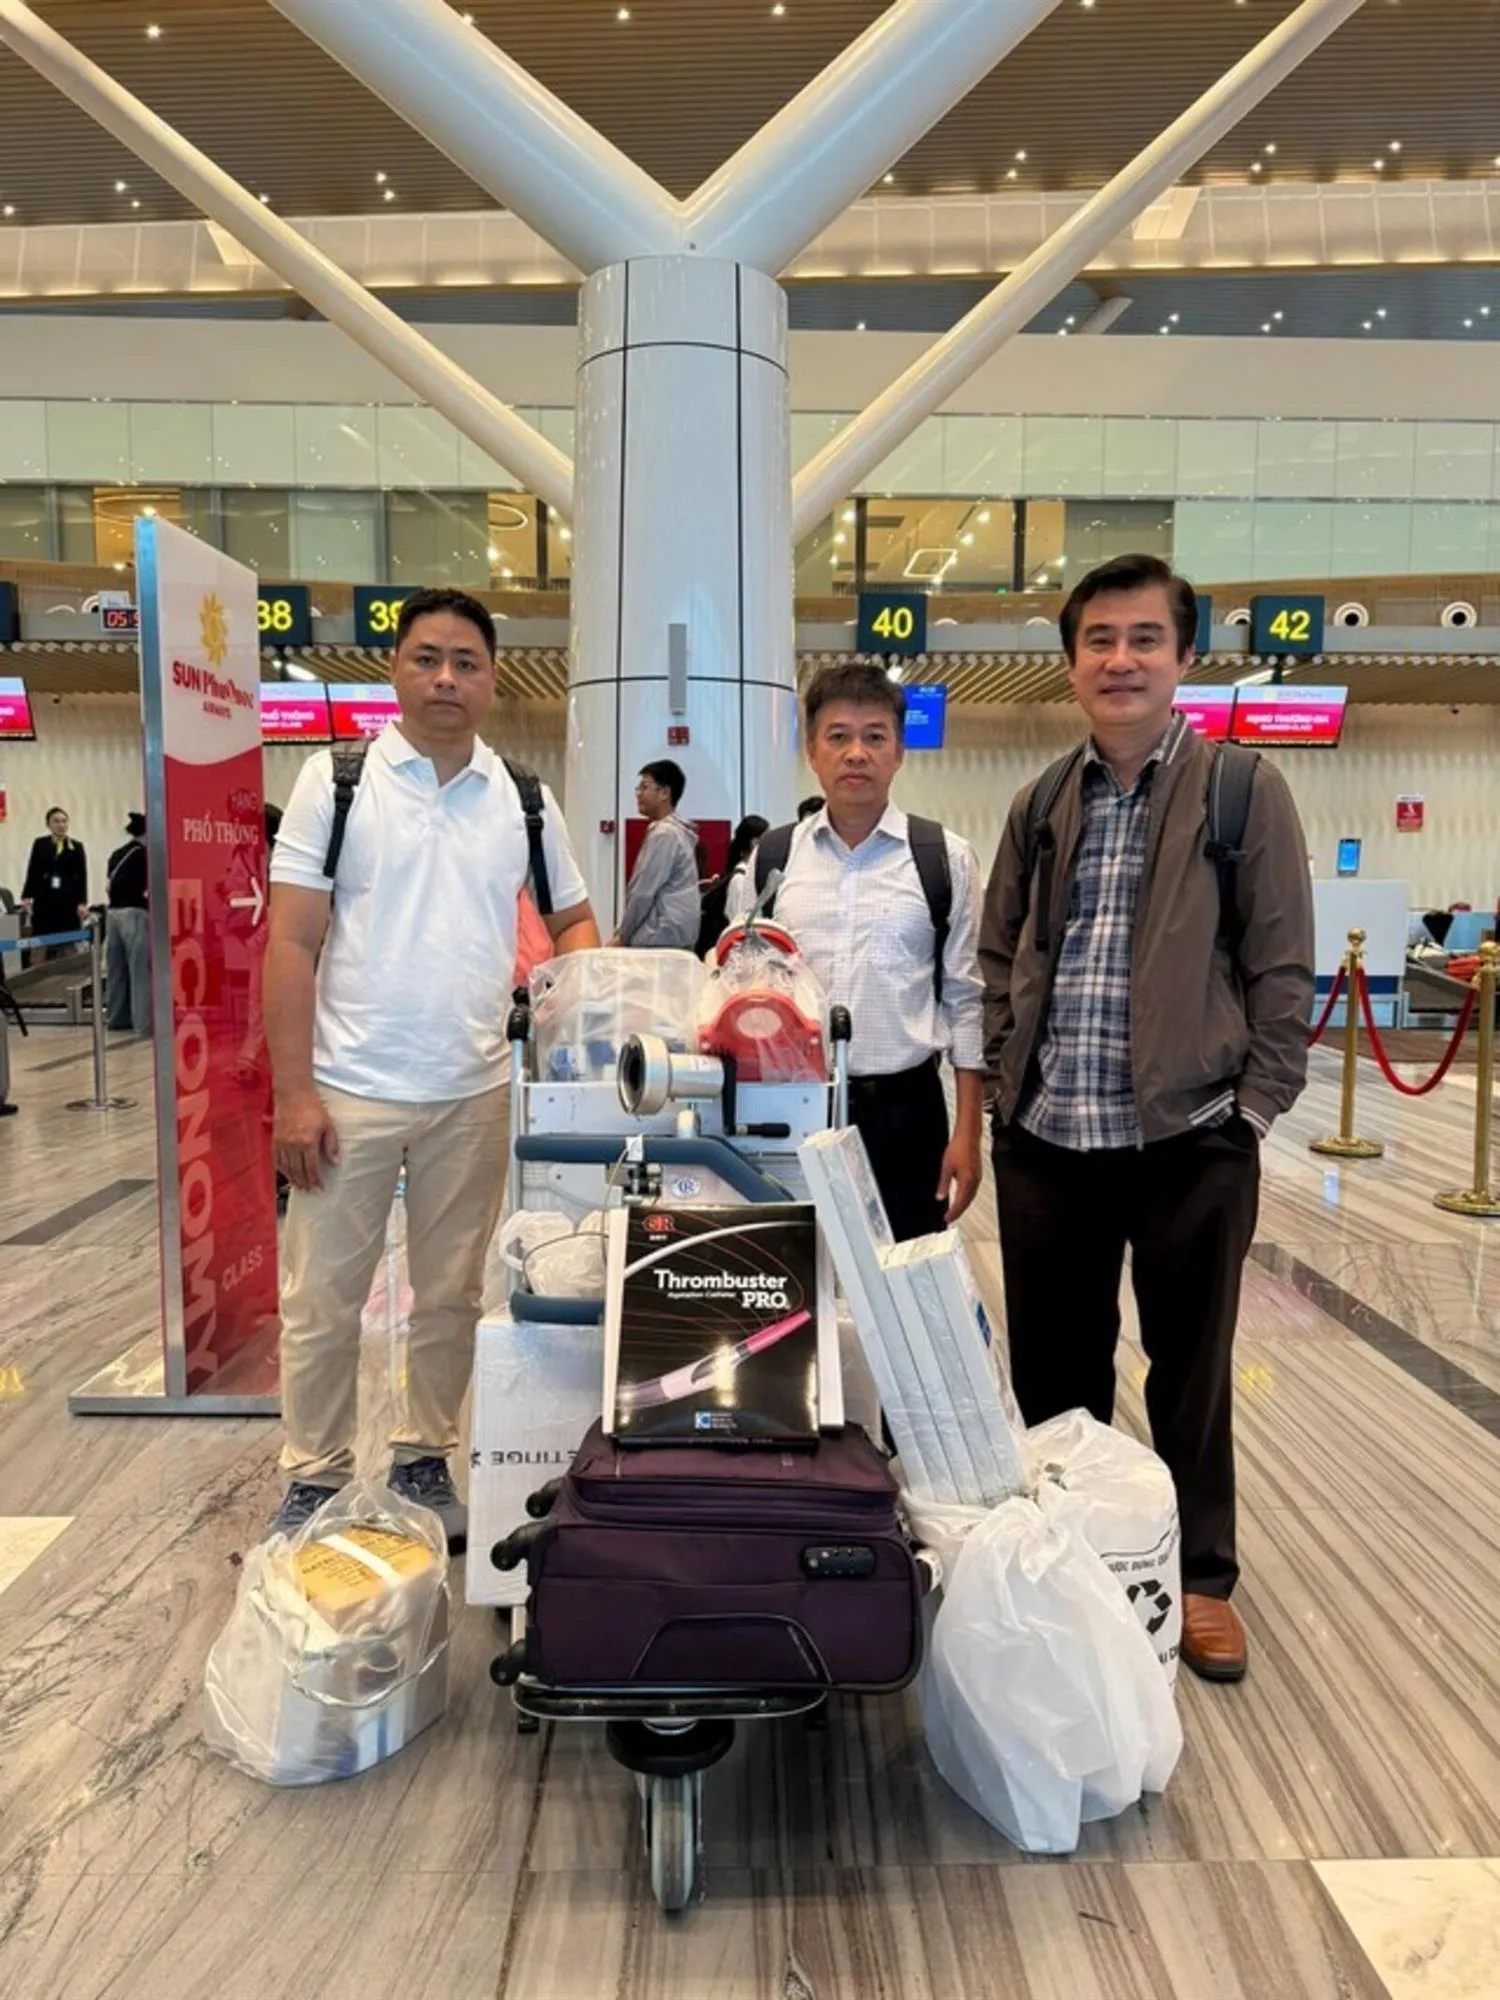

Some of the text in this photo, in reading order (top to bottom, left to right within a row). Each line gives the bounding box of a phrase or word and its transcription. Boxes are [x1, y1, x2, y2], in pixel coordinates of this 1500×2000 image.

[871, 607, 913, 638] 40
[1269, 610, 1311, 640] 42
[173, 660, 201, 692] SUN
[169, 879, 219, 1375] ECONOMY
[222, 1245, 264, 1291] CLASS
[653, 1268, 788, 1290] Thrombuster
[741, 1290, 788, 1309] PRO
